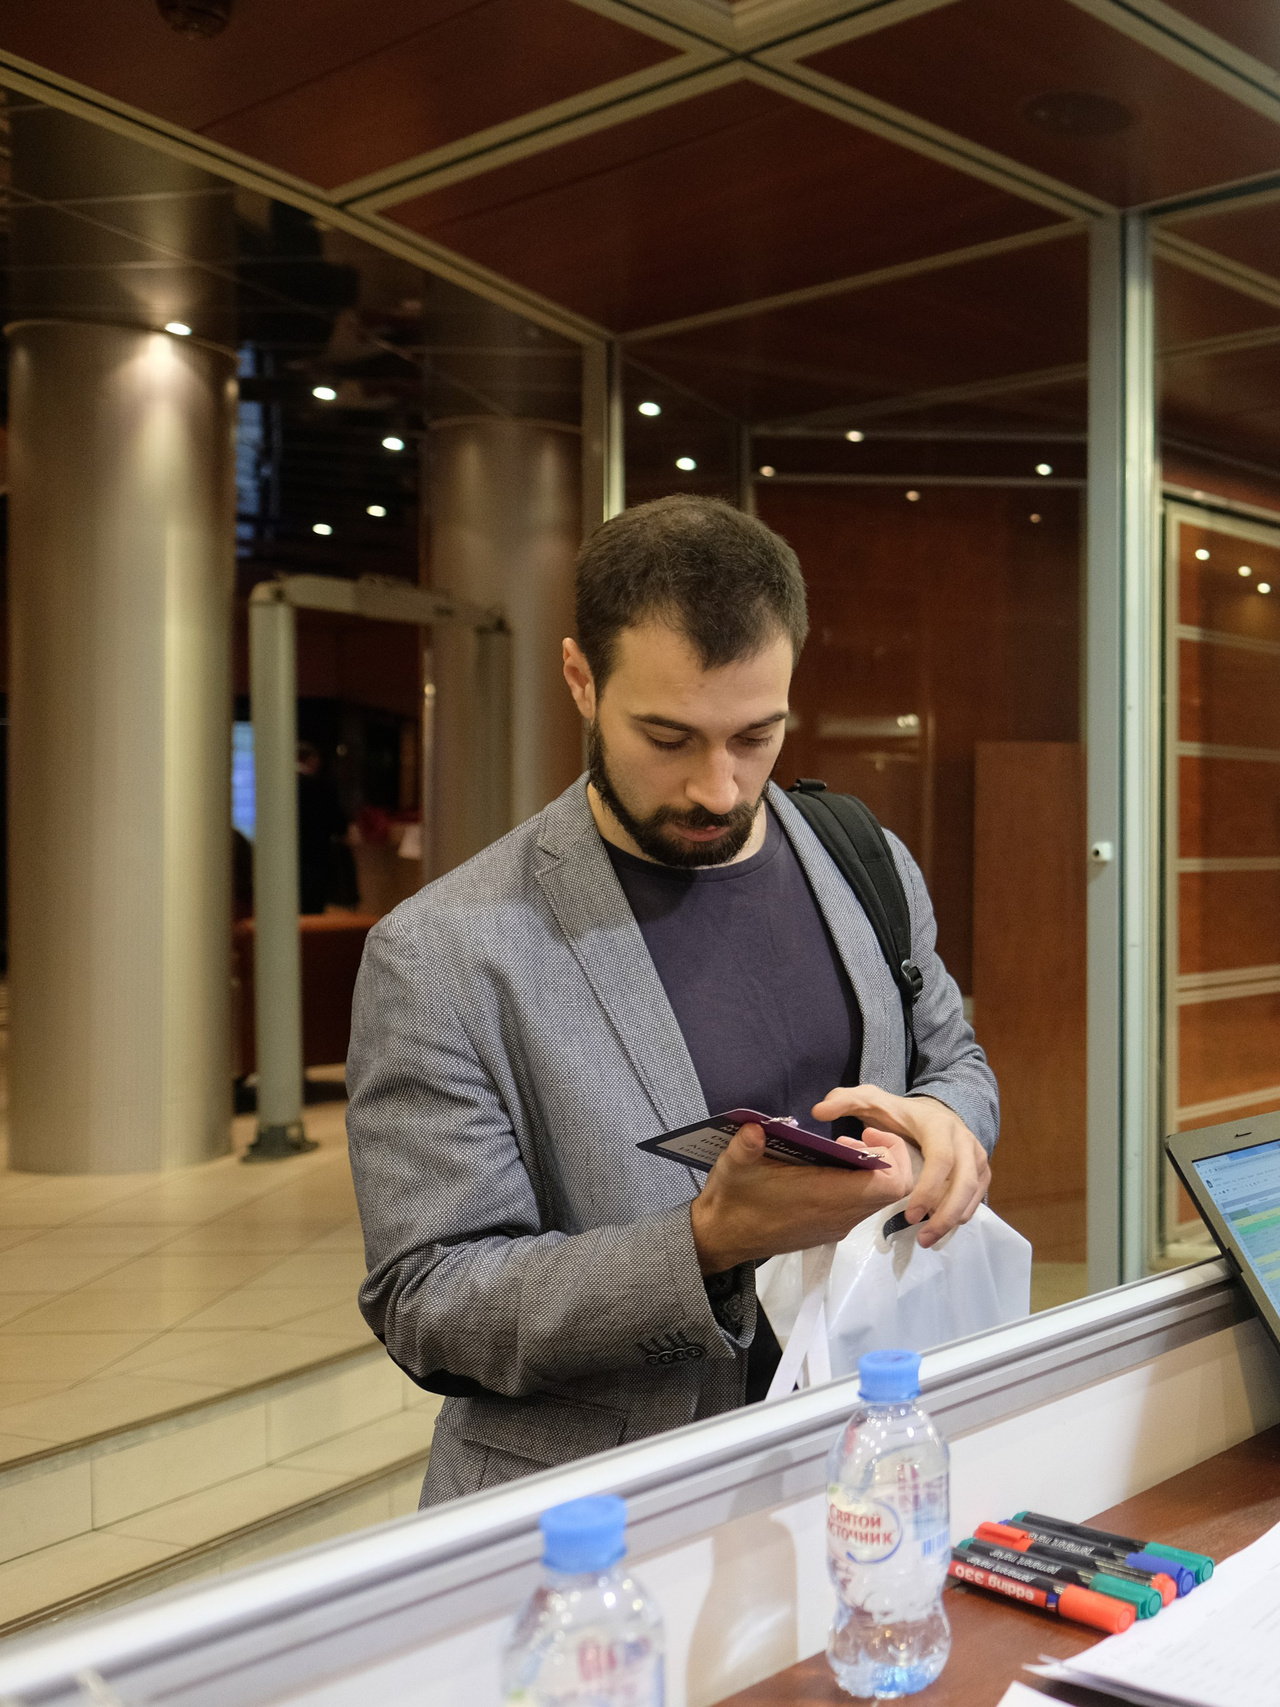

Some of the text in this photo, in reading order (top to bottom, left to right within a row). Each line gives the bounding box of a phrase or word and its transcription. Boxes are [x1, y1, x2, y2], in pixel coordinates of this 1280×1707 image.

[1025, 1531, 1095, 1556] permanent marke
[967, 1556, 1037, 1583] permanent marker
[989, 1549, 1062, 1575] permanent marker
[955, 1564, 1035, 1602] edding 330
